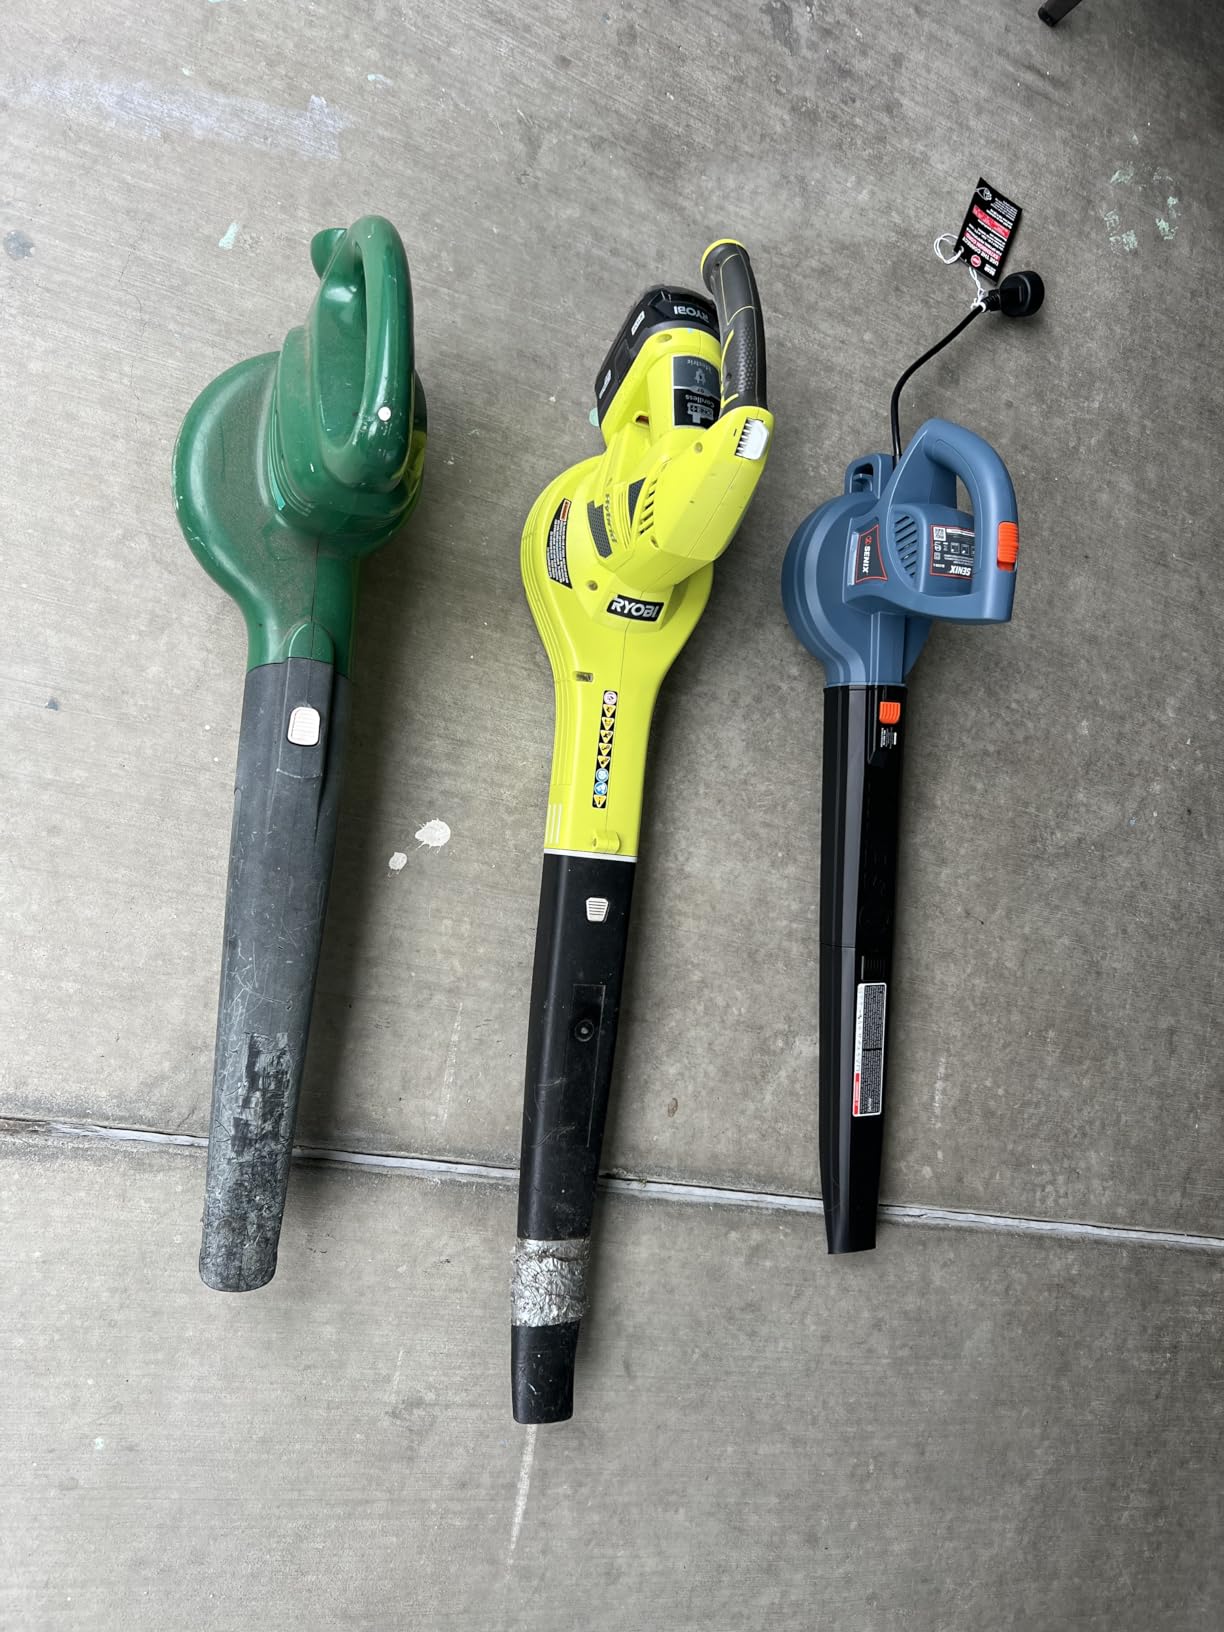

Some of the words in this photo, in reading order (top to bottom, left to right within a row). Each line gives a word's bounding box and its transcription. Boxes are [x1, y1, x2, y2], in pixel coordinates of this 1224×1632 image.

[980, 251, 989, 260] THE
[674, 306, 710, 322] RYOBI
[685, 394, 714, 408] Cordless
[605, 494, 617, 543] Hybrid
[862, 546, 870, 573] SENIX
[950, 565, 972, 576] SENIX
[611, 598, 660, 618] RYOBI
